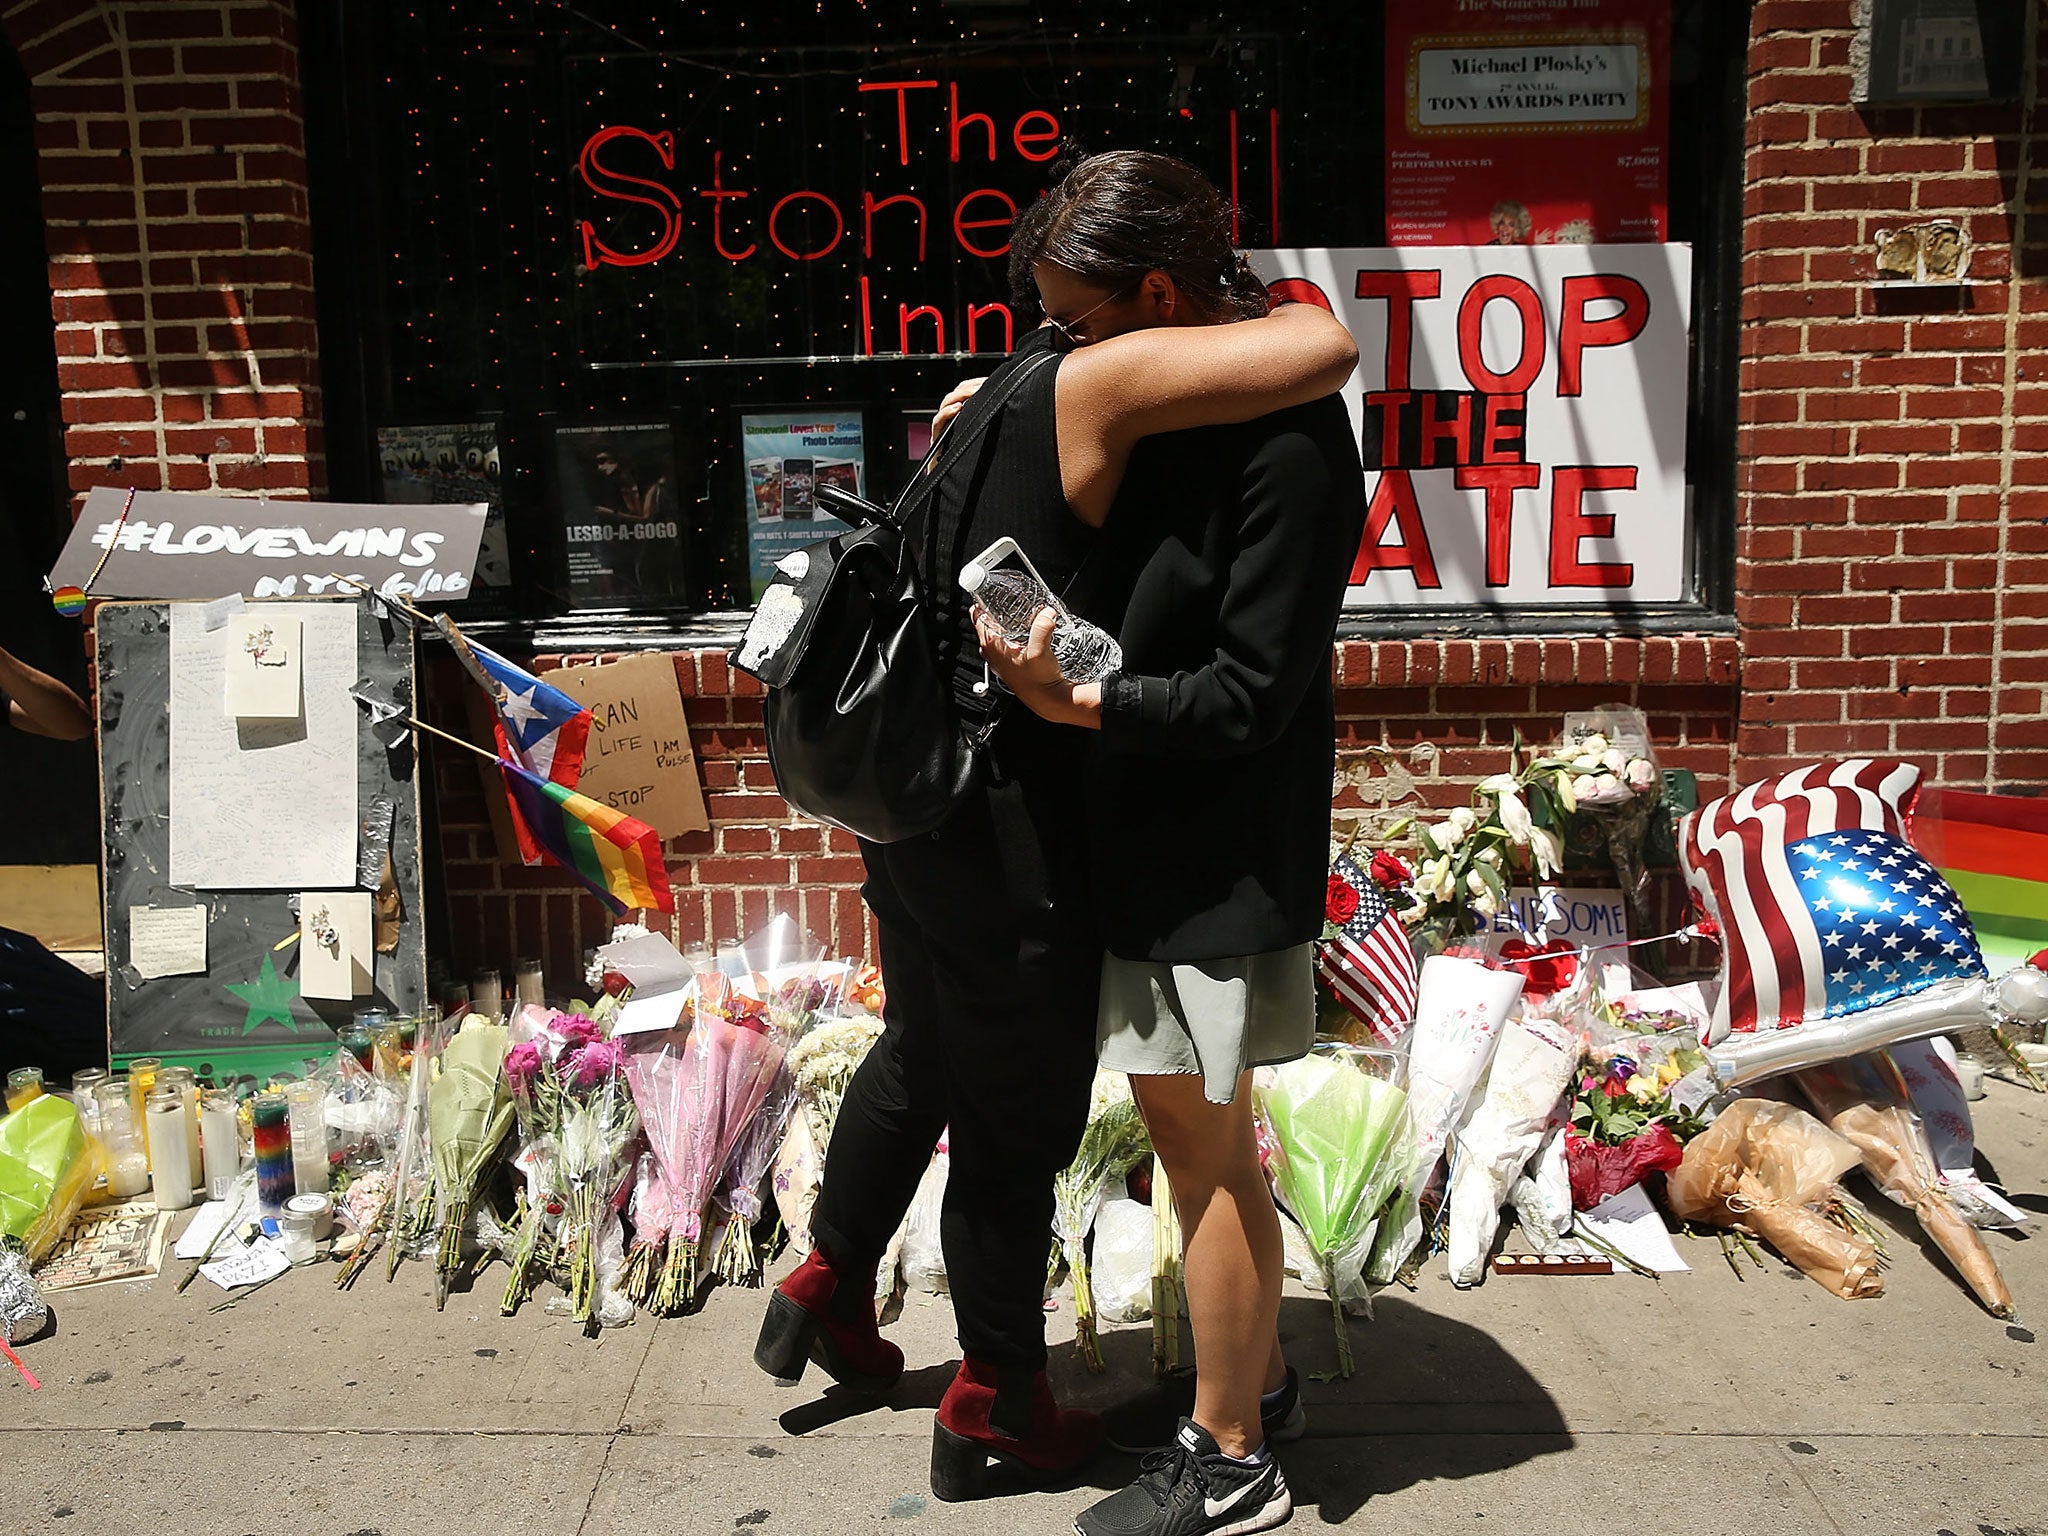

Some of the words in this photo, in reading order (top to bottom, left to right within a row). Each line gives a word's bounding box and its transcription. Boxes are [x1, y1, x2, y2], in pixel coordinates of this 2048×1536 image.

[1451, 57, 1527, 75] Michael
[1533, 54, 1608, 75] Plosky's
[1428, 96, 1481, 112] TONY
[1486, 94, 1564, 110] AWARDS
[1568, 92, 1629, 108] PARTY
[859, 80, 1060, 166] The
[1391, 158, 1479, 169] PERFORMANCES
[1480, 158, 1493, 168] BY
[1617, 156, 1660, 167] $7,000
[861, 275, 1014, 356] Inn
[745, 424, 789, 435] Stonewall
[789, 424, 814, 434] Loves
[815, 423, 836, 433] Your
[1366, 392, 1525, 467] THE
[802, 436, 828, 446] Photo
[828, 435, 862, 446] Contest
[566, 522, 678, 543] LESBO-A-GOGO
[1347, 463, 1638, 590] ATE
[91, 517, 445, 568] #LOVEWINS
[252, 571, 366, 598] NYC
[380, 567, 469, 598] 6/16
[599, 735, 642, 756] LIFE
[653, 740, 659, 754] I
[664, 739, 680, 753] AM
[656, 753, 691, 769] PULSE
[607, 785, 655, 808] STOP
[1551, 894, 1625, 937] SOME
